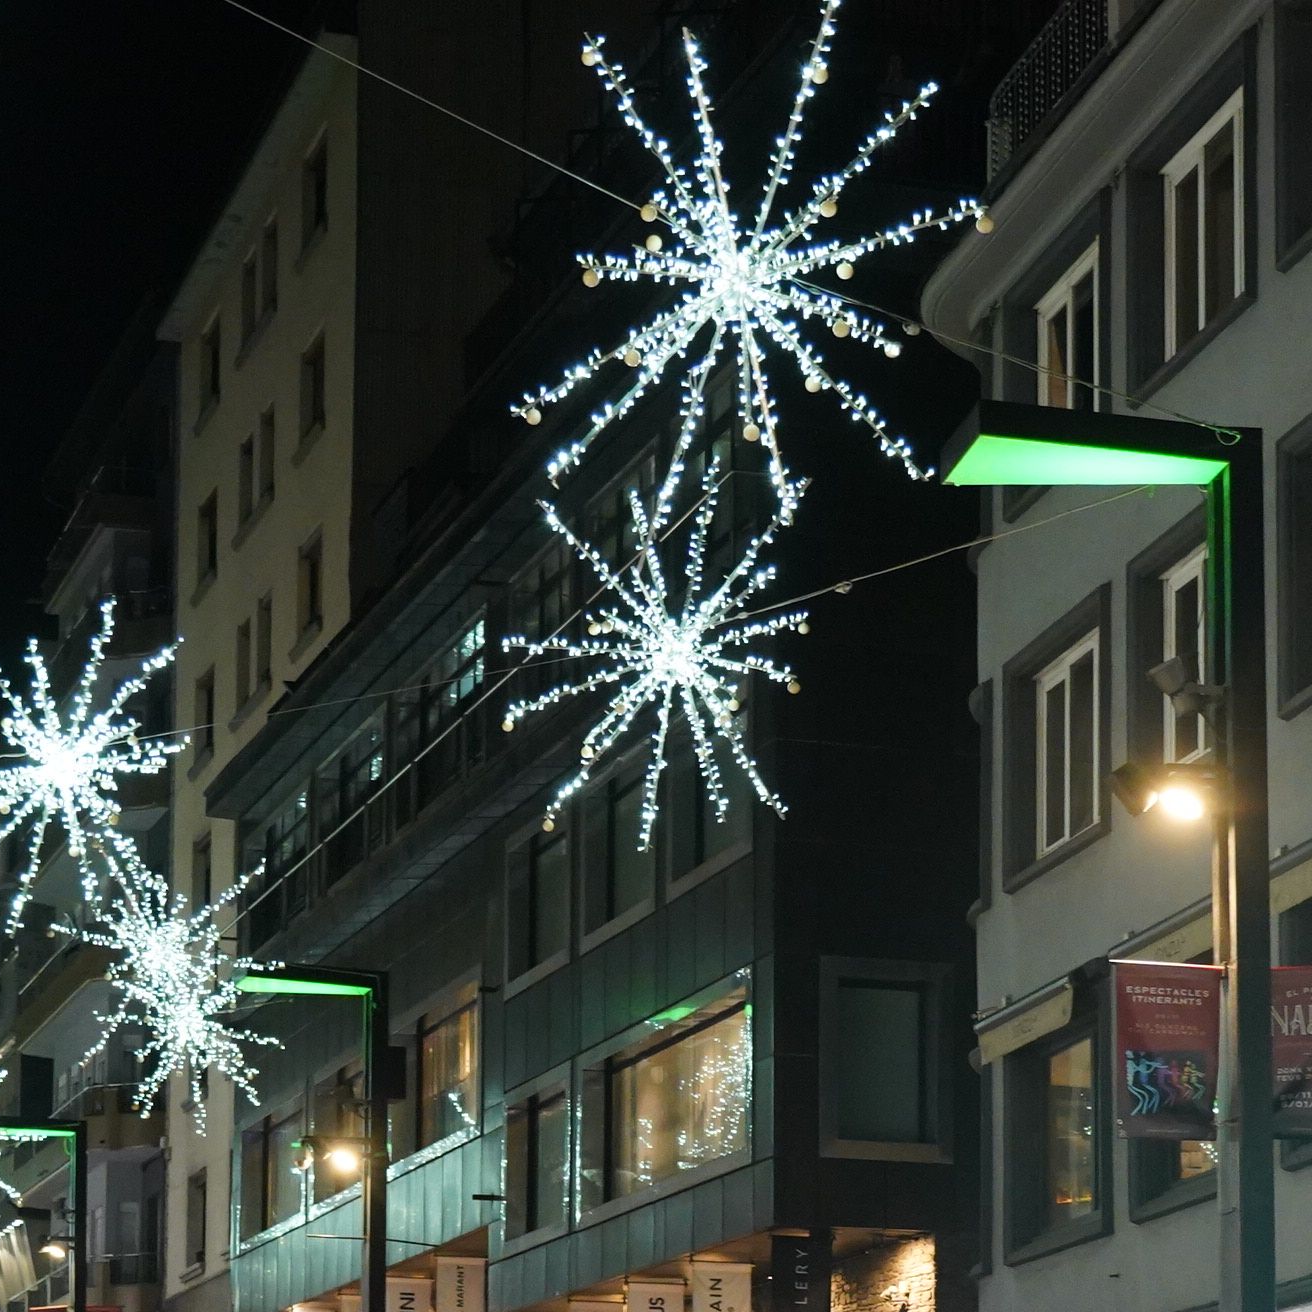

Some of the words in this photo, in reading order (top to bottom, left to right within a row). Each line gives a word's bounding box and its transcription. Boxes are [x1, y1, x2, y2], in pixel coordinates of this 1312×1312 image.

[1125, 985, 1210, 999] ESPECTACLES
[1132, 995, 1203, 1006] ITINERANTS
[456, 1265, 465, 1308] MARANT
